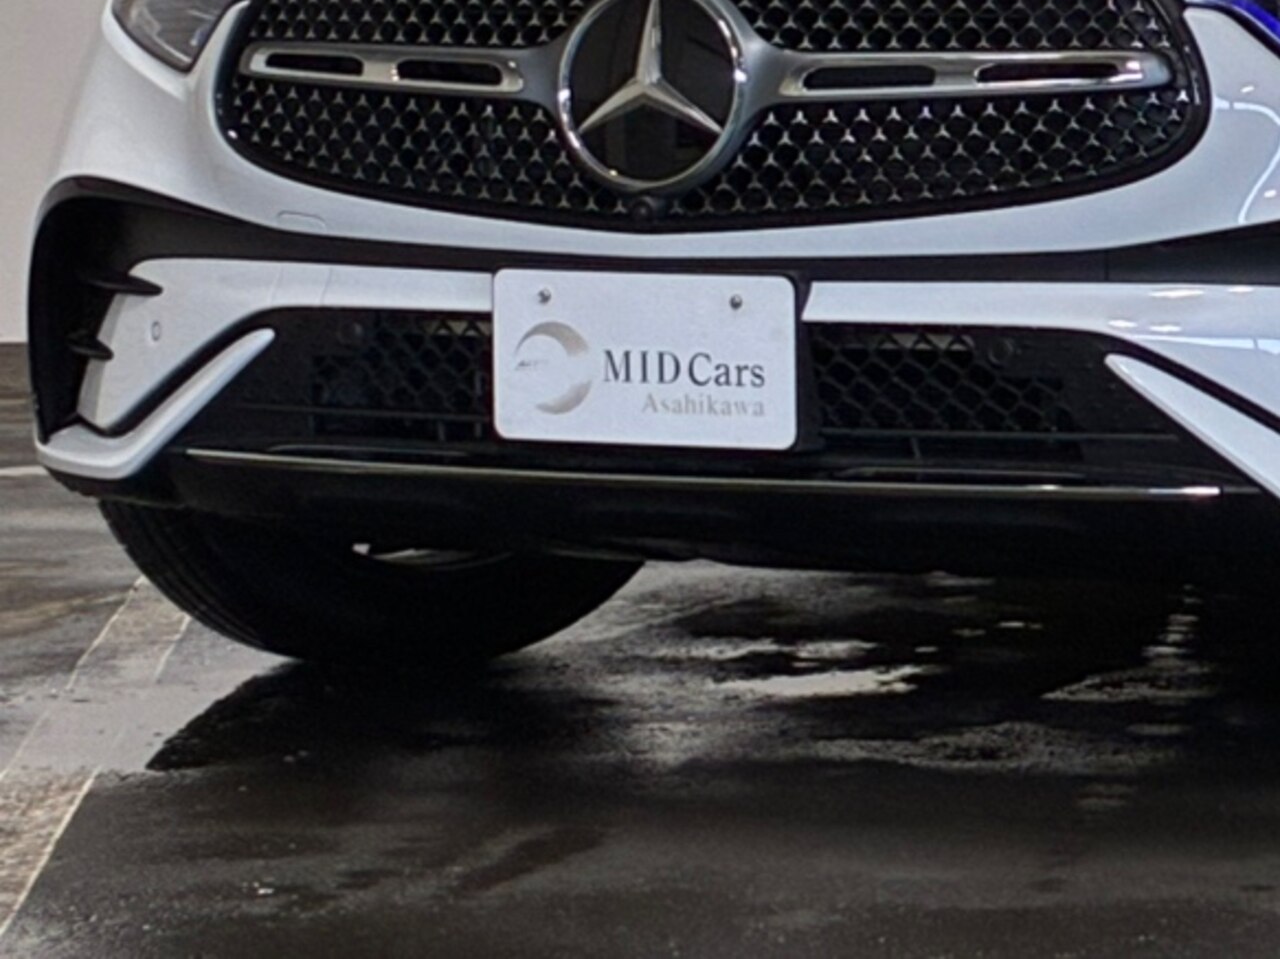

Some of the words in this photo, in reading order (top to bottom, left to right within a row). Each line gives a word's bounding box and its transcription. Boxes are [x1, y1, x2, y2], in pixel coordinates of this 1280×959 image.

[604, 350, 681, 384] MID
[688, 352, 765, 387] Cars
[642, 393, 765, 416] Asahikawa
